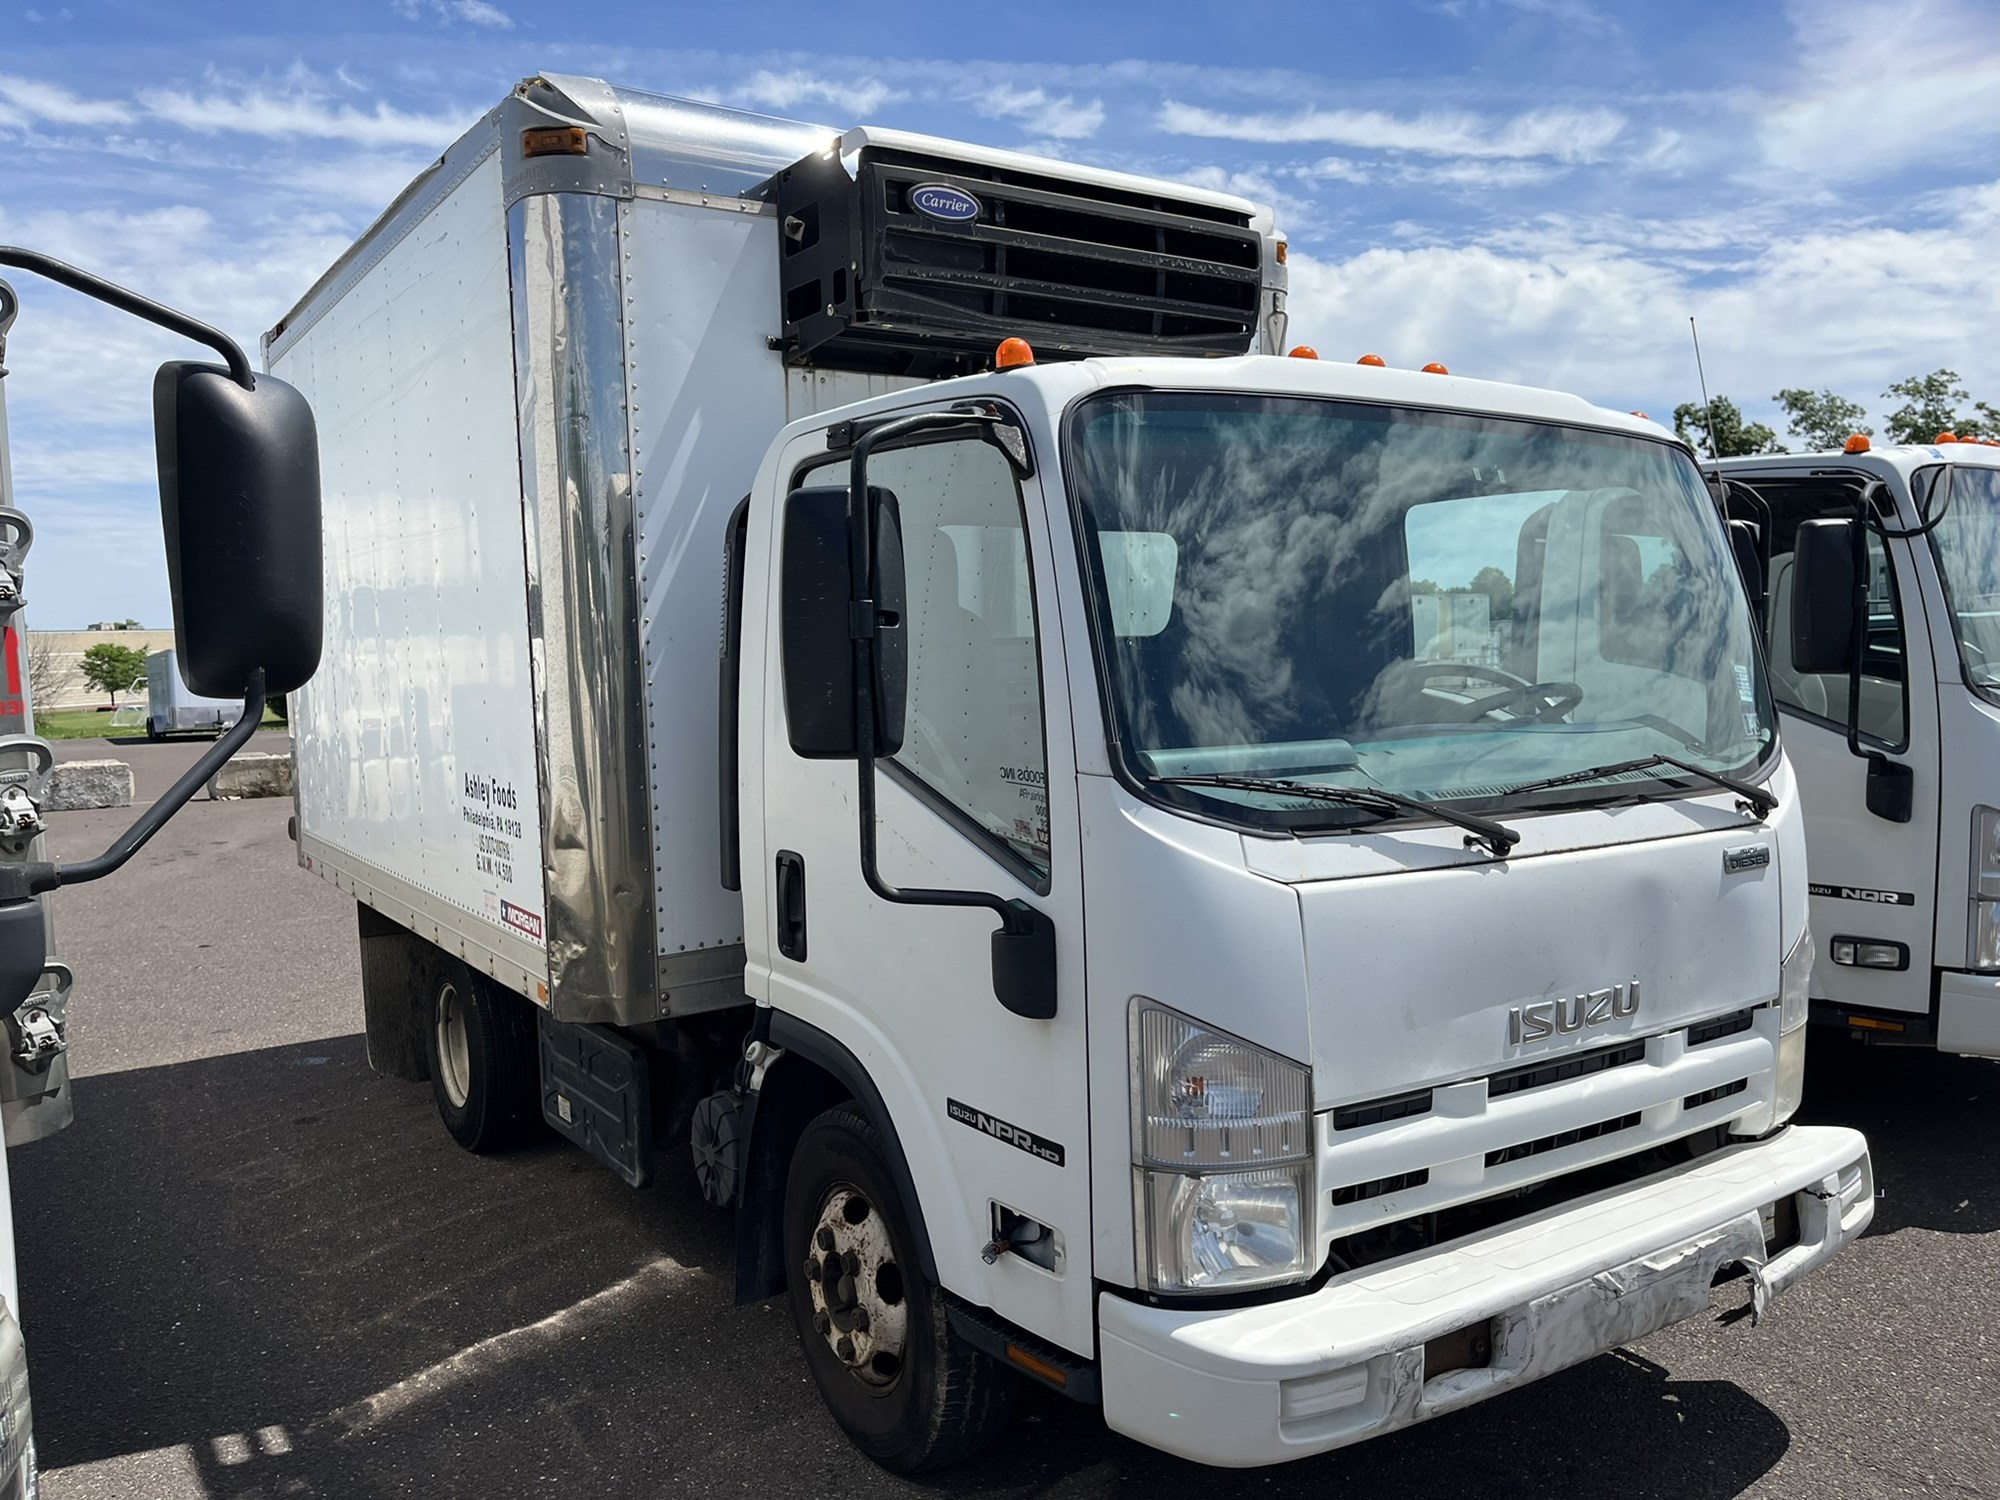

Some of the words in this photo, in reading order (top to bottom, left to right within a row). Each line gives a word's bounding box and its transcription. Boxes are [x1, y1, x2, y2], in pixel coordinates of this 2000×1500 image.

[921, 193, 969, 212] Carrier
[464, 772, 490, 810] Ashley
[491, 777, 517, 810] Foods
[1730, 853, 1769, 870] DIESEL
[1808, 885, 1831, 895] UZU
[1841, 887, 1899, 904] NQR
[1509, 980, 1640, 1047] ISUZU
[949, 1104, 976, 1124] ISUZU
[977, 1112, 1031, 1152] NPR
